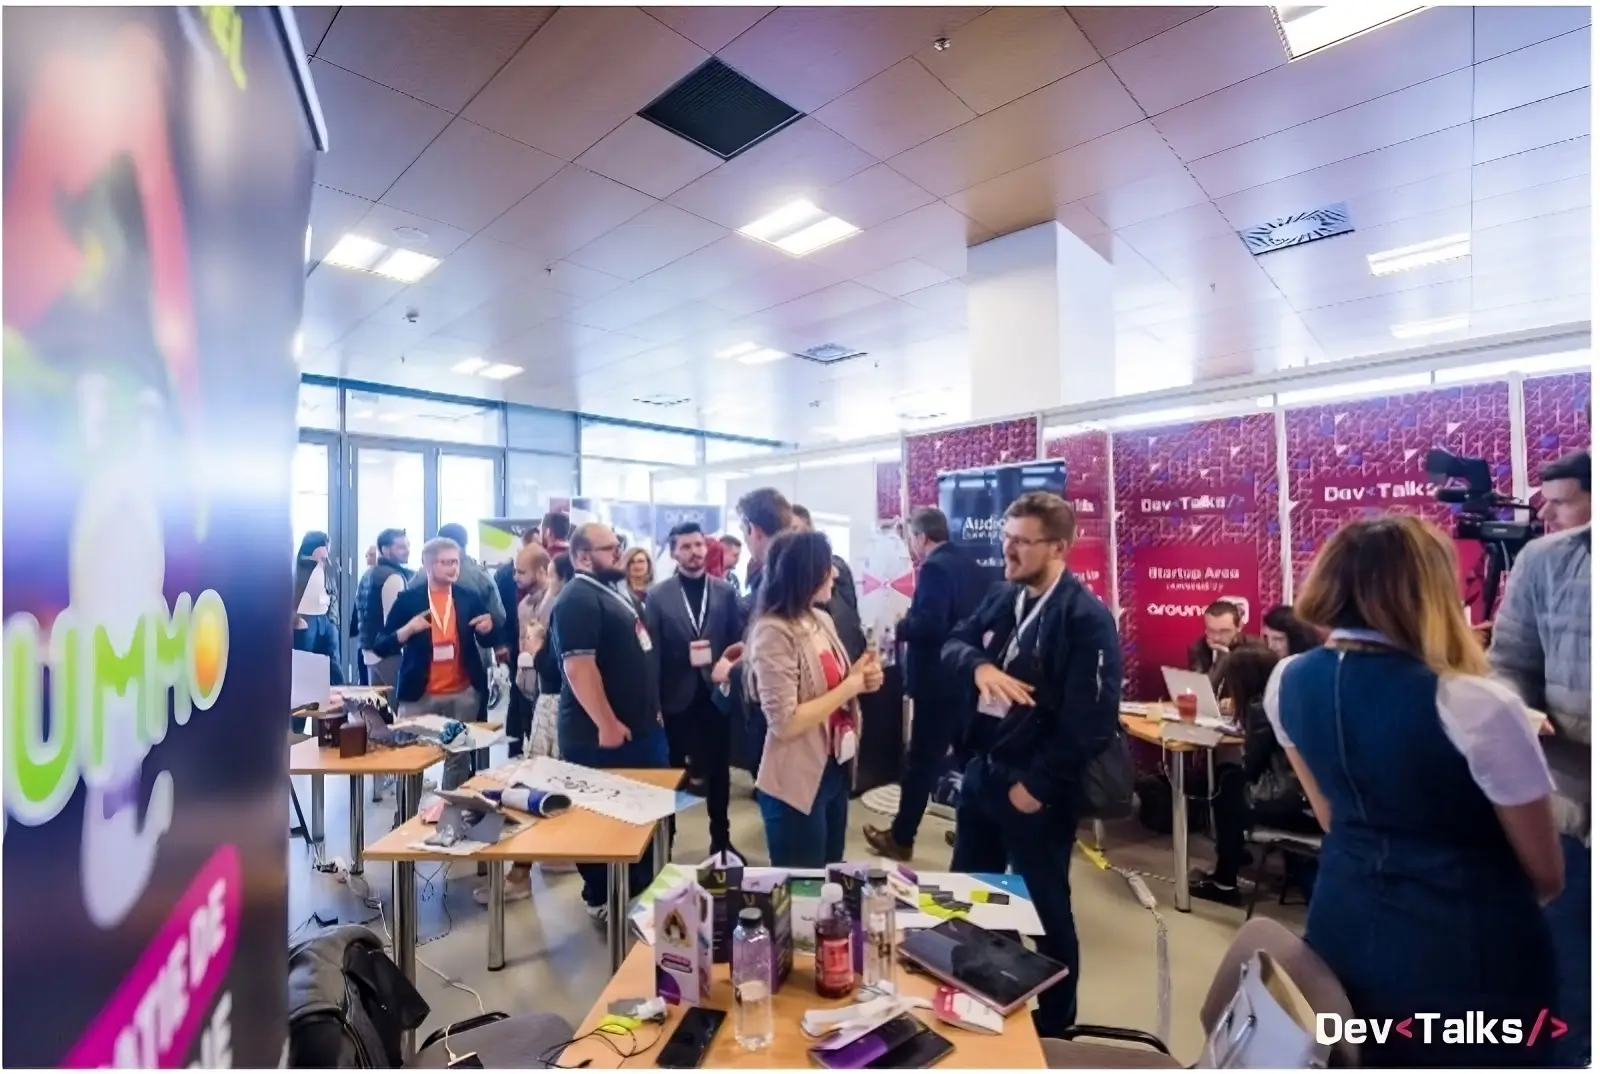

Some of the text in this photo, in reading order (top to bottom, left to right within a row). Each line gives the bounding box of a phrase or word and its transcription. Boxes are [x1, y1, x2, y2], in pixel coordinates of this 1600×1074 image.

[1146, 602, 1207, 617] aroun
[3, 589, 229, 827] UMMO
[97, 935, 190, 1068] ATIE
